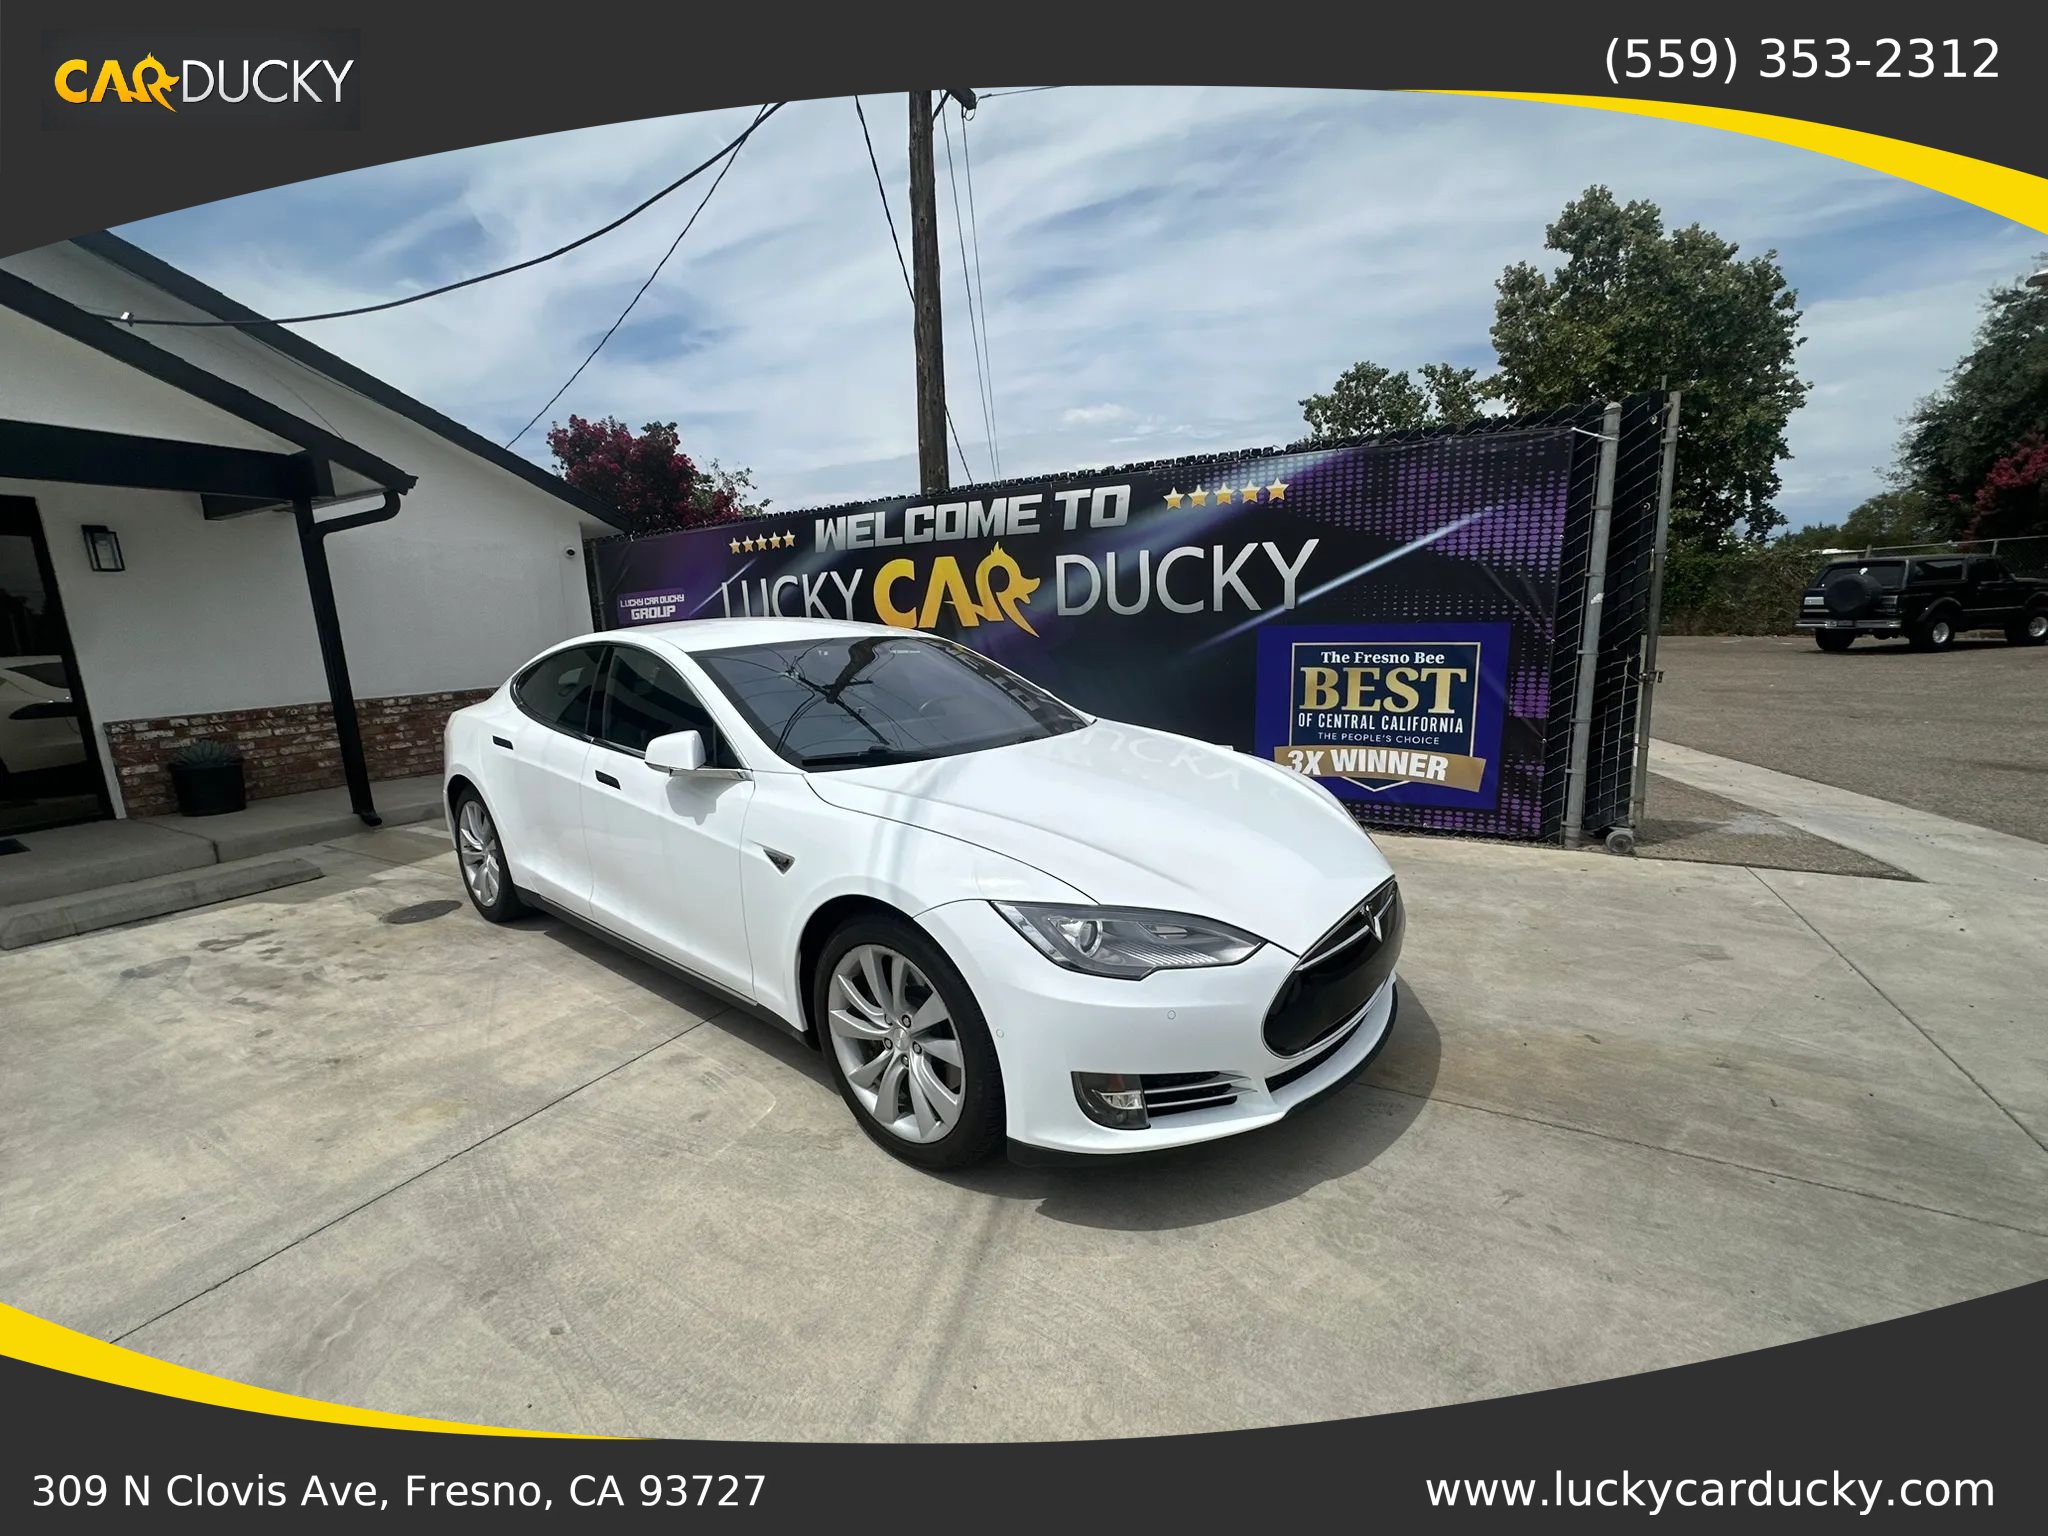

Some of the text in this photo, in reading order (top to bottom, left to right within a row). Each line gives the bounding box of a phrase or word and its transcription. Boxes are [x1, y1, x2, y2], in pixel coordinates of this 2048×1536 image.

[815, 484, 1131, 553] WELCOME TO
[873, 541, 1041, 637] CAR
[1056, 538, 1320, 616] DUCKY
[620, 594, 685, 608] LUCKY CAR DUCKY
[631, 605, 676, 620] GROUP
[1321, 651, 1445, 664] The Fresno Bee
[1299, 667, 1467, 714] BEST
[1298, 712, 1464, 734] OF CENTRAL CALIFORNIA
[1318, 732, 1440, 745] THE PEOPLE'S CHOICE
[1287, 749, 1449, 782] 3X WINNER
